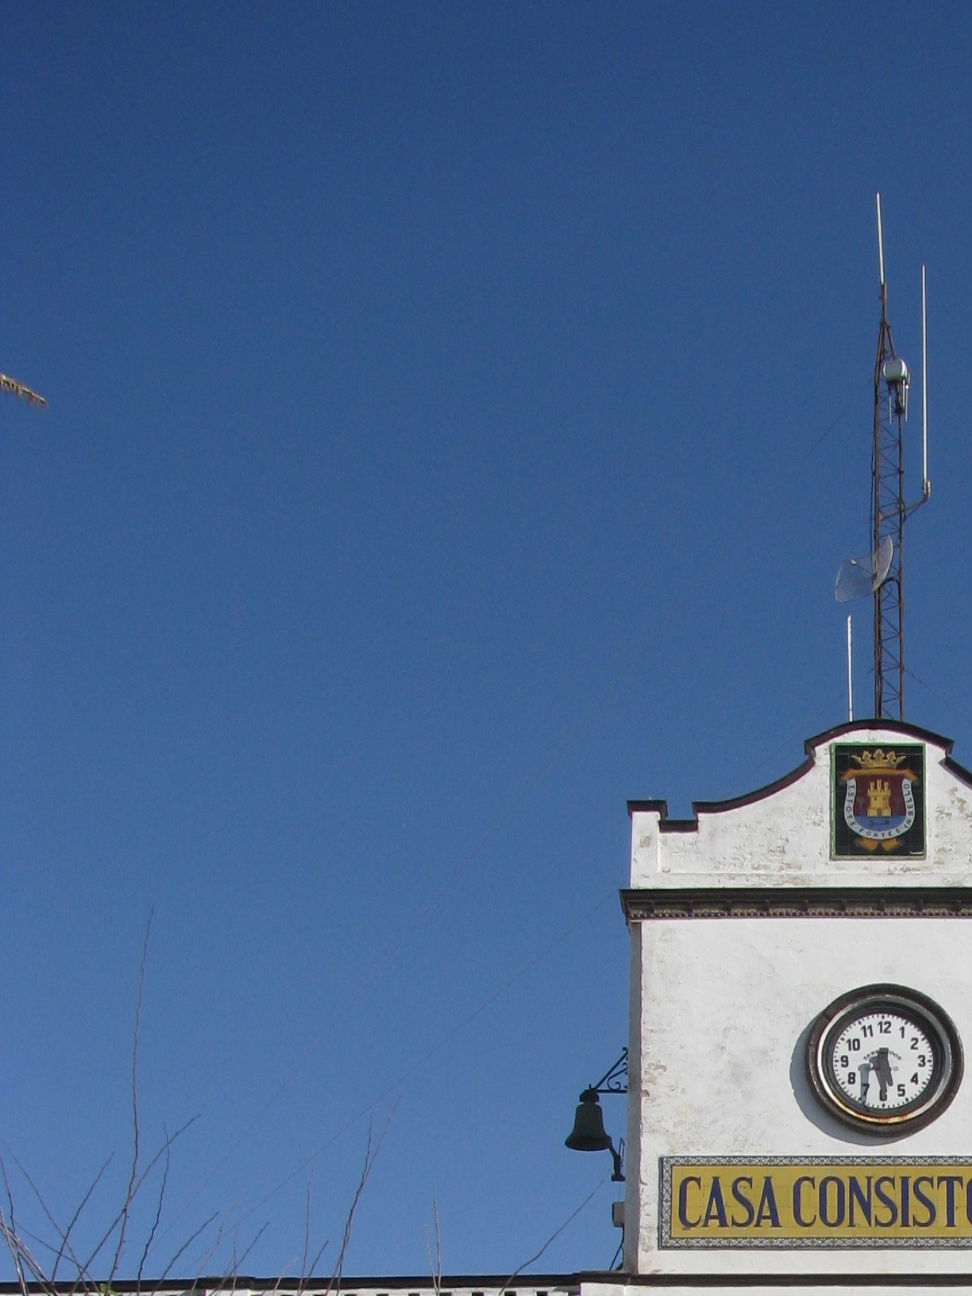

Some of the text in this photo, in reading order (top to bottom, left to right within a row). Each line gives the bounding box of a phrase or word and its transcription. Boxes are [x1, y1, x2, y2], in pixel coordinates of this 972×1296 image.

[861, 1025, 874, 1037] 11
[877, 1021, 891, 1034] 12
[899, 1026, 905, 1038] 1
[847, 1038, 860, 1051] 10
[910, 1037, 919, 1050] 2
[840, 1055, 849, 1067] 9
[917, 1055, 926, 1067] 3
[848, 1072, 856, 1085] 8
[910, 1072, 919, 1085] 4
[862, 1084, 870, 1096] 7
[897, 1084, 905, 1097] 5
[678, 1175, 782, 1229] CASA
